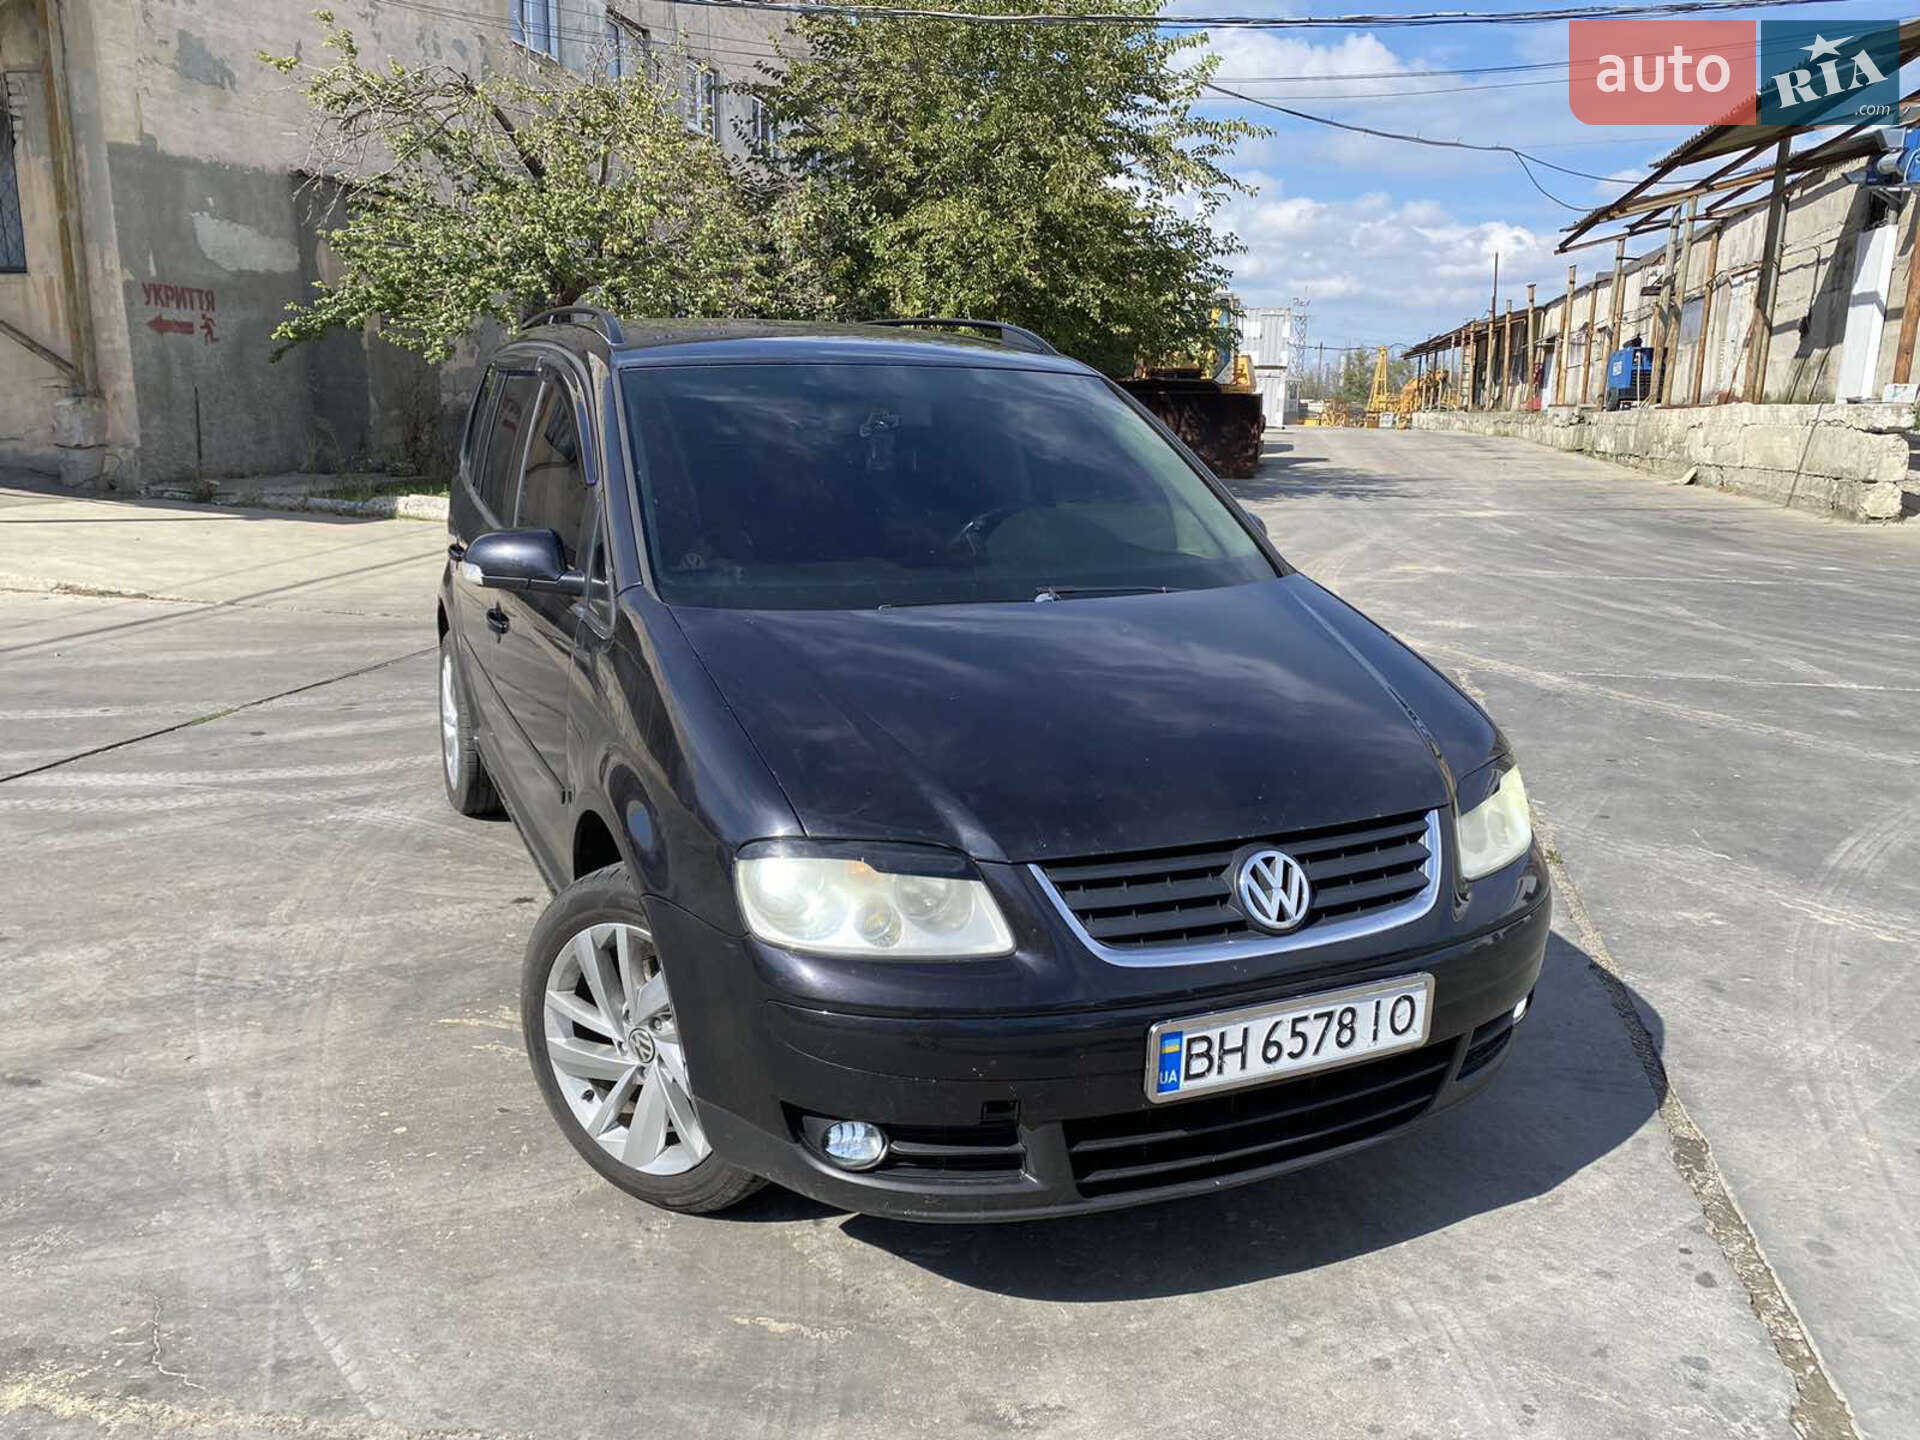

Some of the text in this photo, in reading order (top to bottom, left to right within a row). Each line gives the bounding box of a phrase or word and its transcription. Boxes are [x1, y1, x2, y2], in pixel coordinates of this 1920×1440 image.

[141, 282, 215, 312] УКРИТТЯ
[1183, 1027, 1249, 1081] BH
[1261, 1006, 1357, 1064] 6578
[1159, 1070, 1178, 1085] UA
